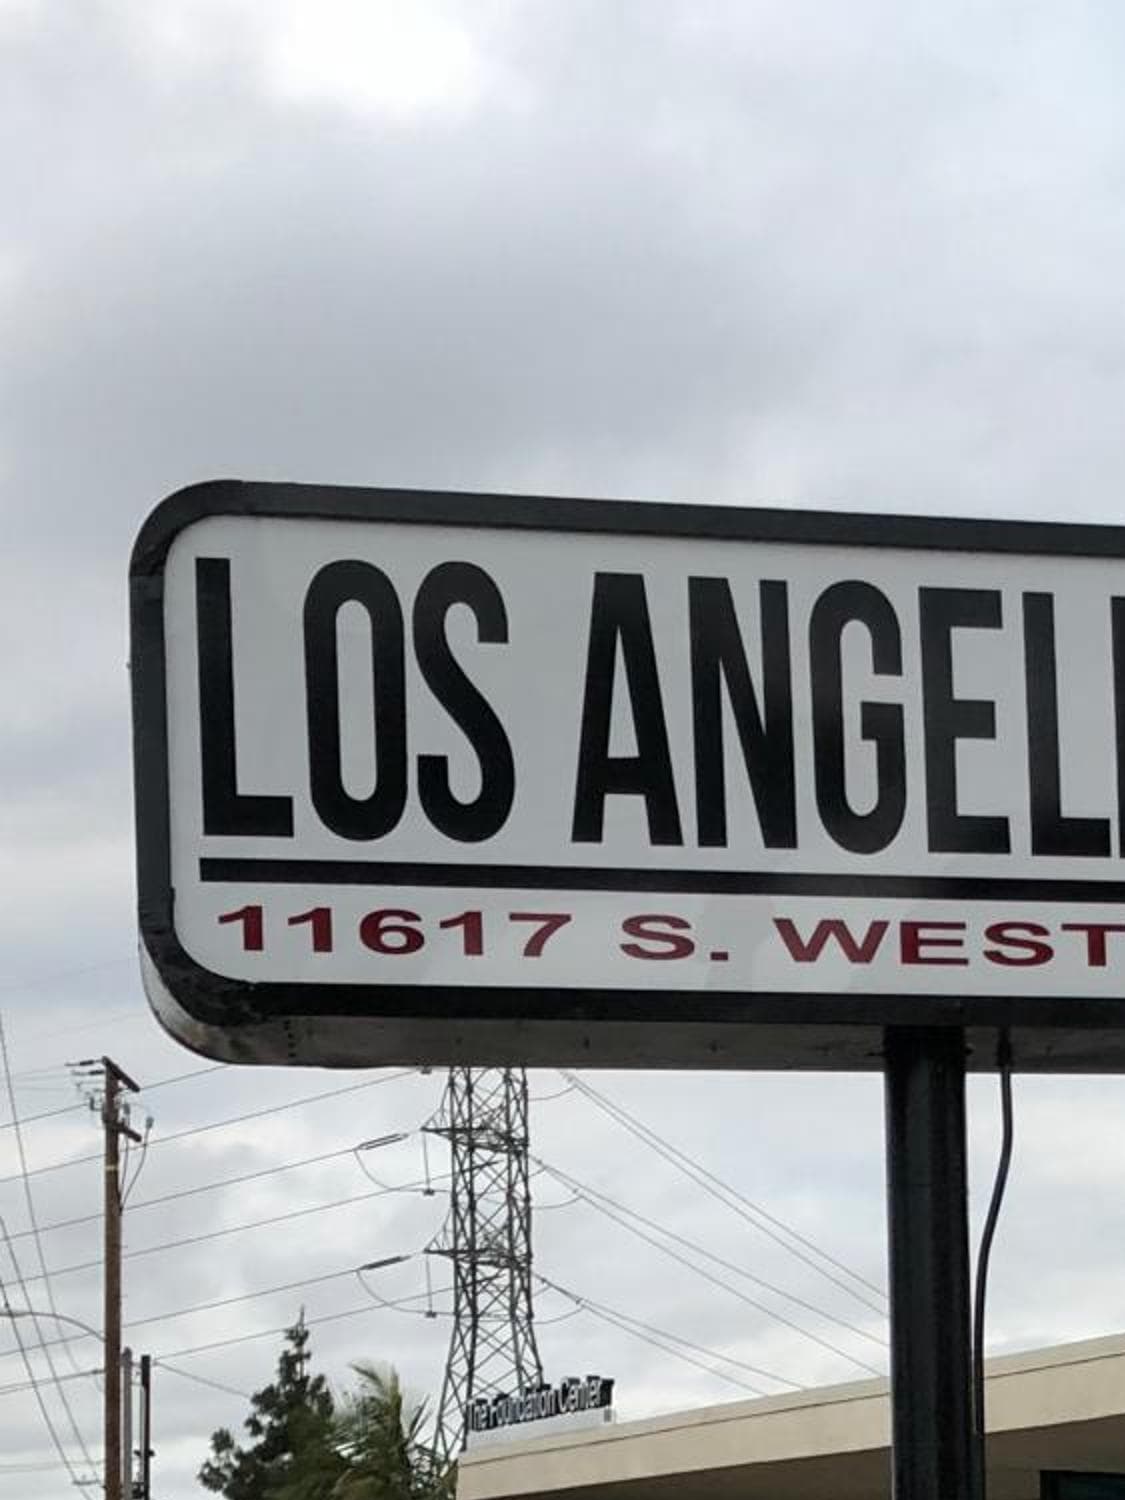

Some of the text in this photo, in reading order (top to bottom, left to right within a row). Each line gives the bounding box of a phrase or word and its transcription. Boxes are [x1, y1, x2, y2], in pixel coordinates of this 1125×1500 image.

[195, 557, 516, 843] LOS
[218, 905, 572, 958] 11617
[620, 915, 729, 961] S.
[558, 1376, 613, 1414] Center
